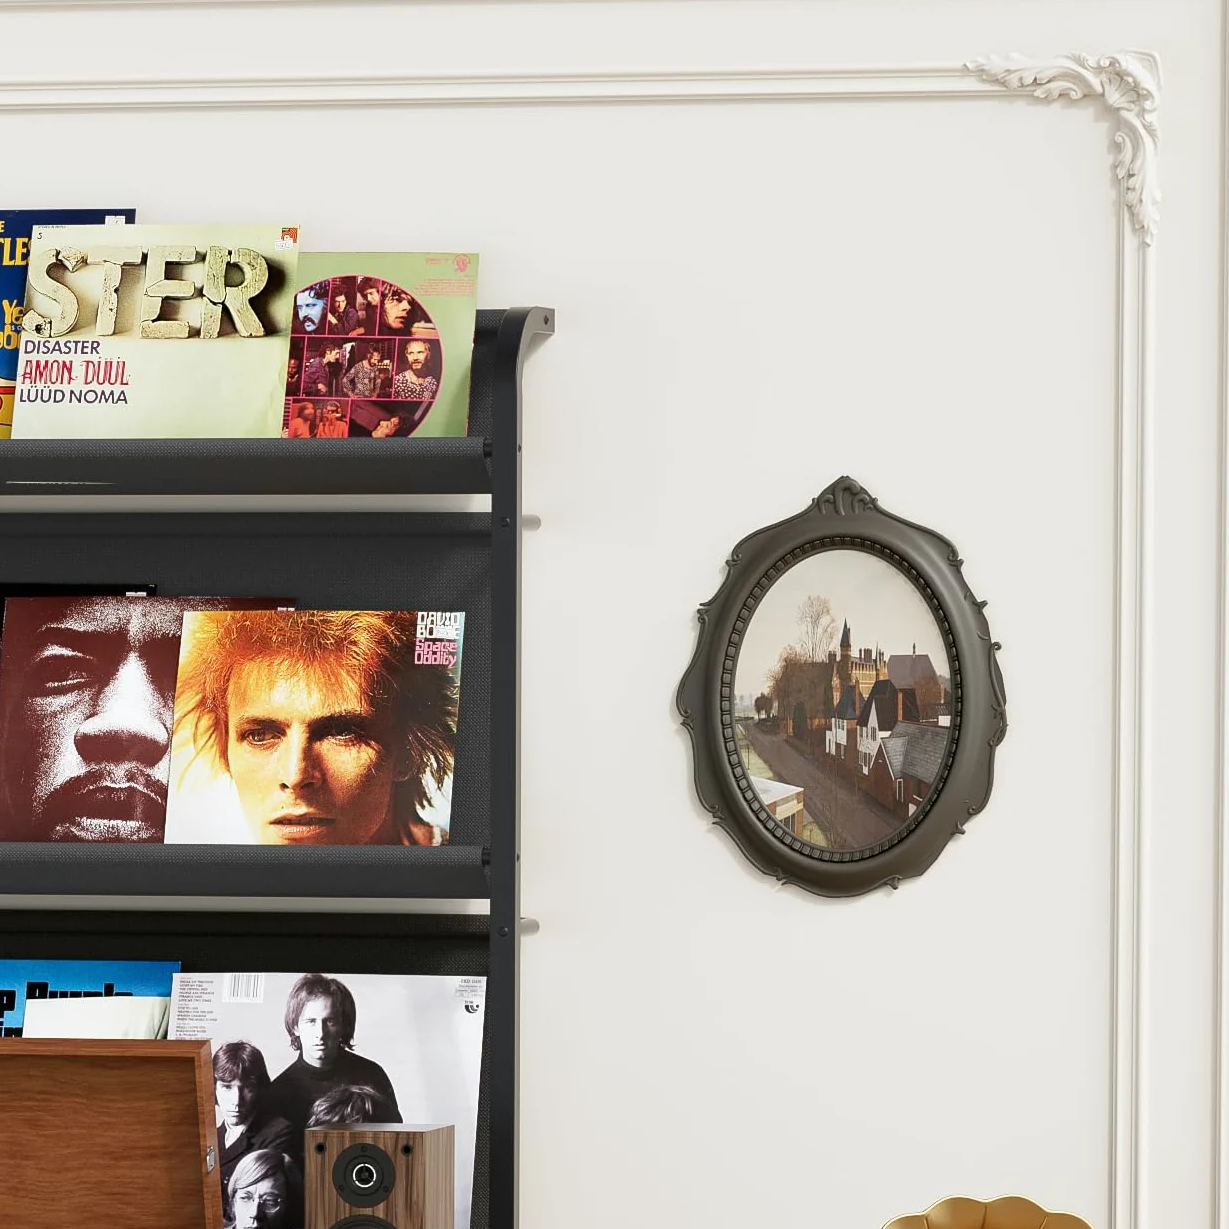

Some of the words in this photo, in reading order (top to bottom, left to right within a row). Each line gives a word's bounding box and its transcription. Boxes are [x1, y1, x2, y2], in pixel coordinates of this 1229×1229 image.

[22, 245, 269, 339] STER
[23, 340, 101, 355] DISASTER
[21, 359, 74, 385] AMON
[19, 386, 66, 403] LÜÜD
[69, 389, 129, 405] NOMA
[417, 612, 460, 625] DAVID
[416, 625, 461, 639] BOE
[415, 638, 458, 653] Space
[414, 650, 457, 669] Oddity
